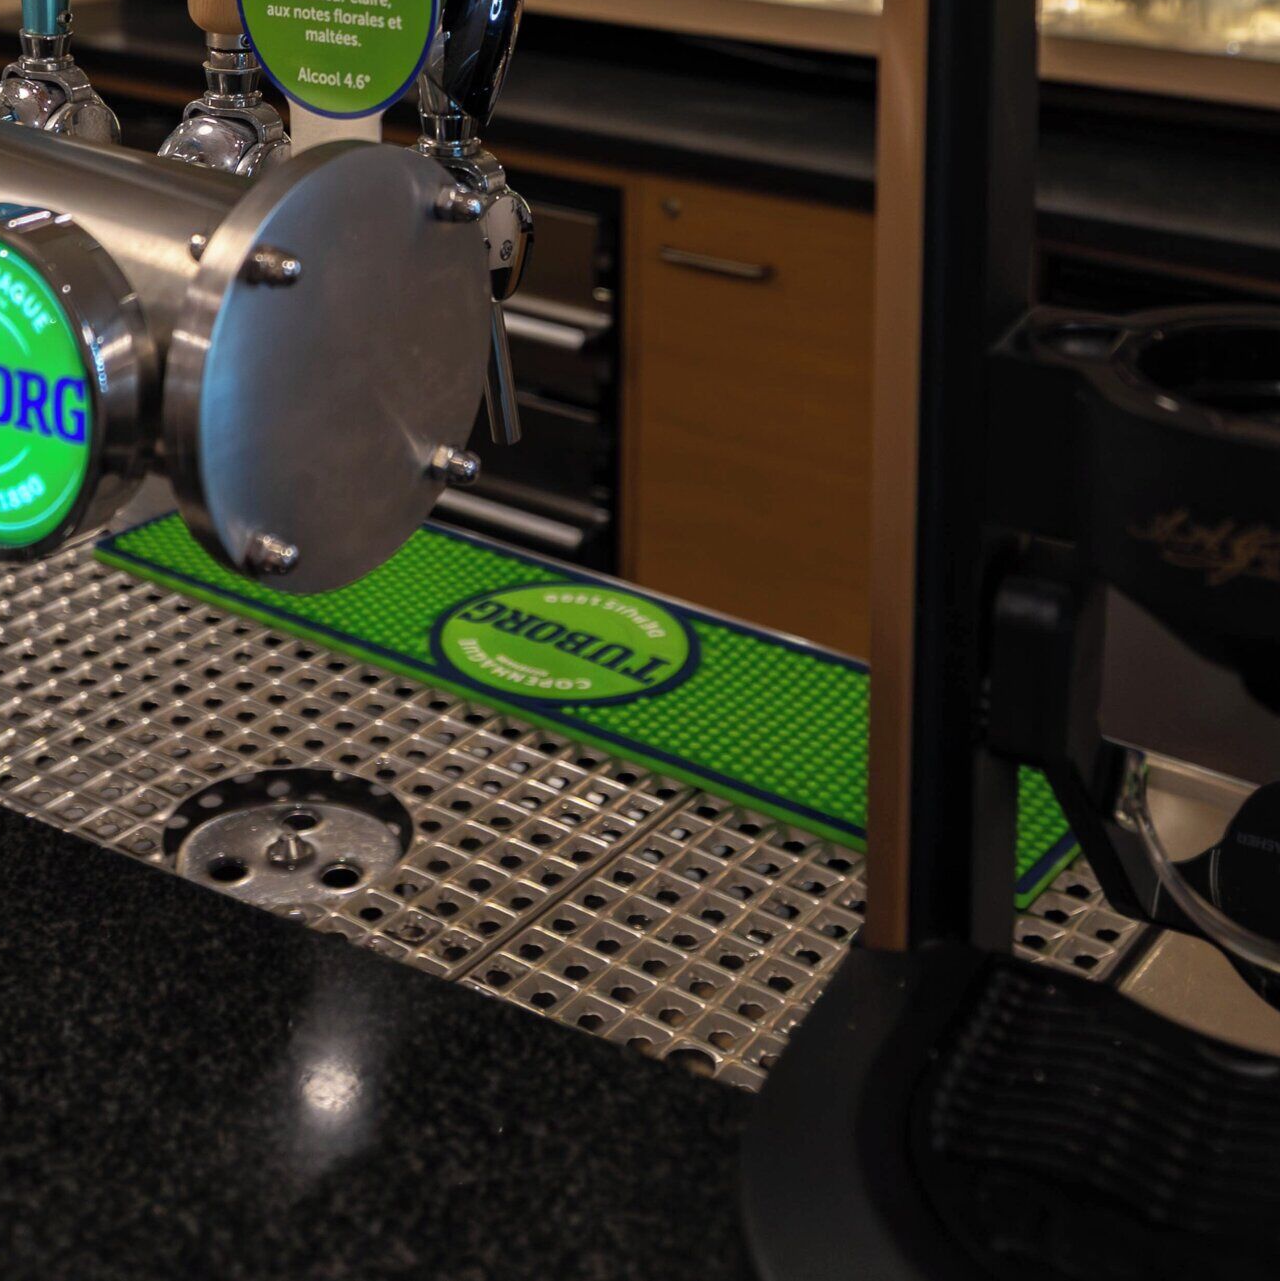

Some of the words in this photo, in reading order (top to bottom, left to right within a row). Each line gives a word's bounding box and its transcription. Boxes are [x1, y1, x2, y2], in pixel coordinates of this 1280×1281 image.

[266, 4, 290, 18] aux
[293, 7, 331, 23] notes
[333, 8, 385, 29] florales
[387, 15, 403, 30] et
[305, 28, 362, 47] maltées.
[297, 66, 341, 87] Alcool
[457, 599, 671, 686] TUBORG
[457, 637, 593, 691] COPENHAGUE
